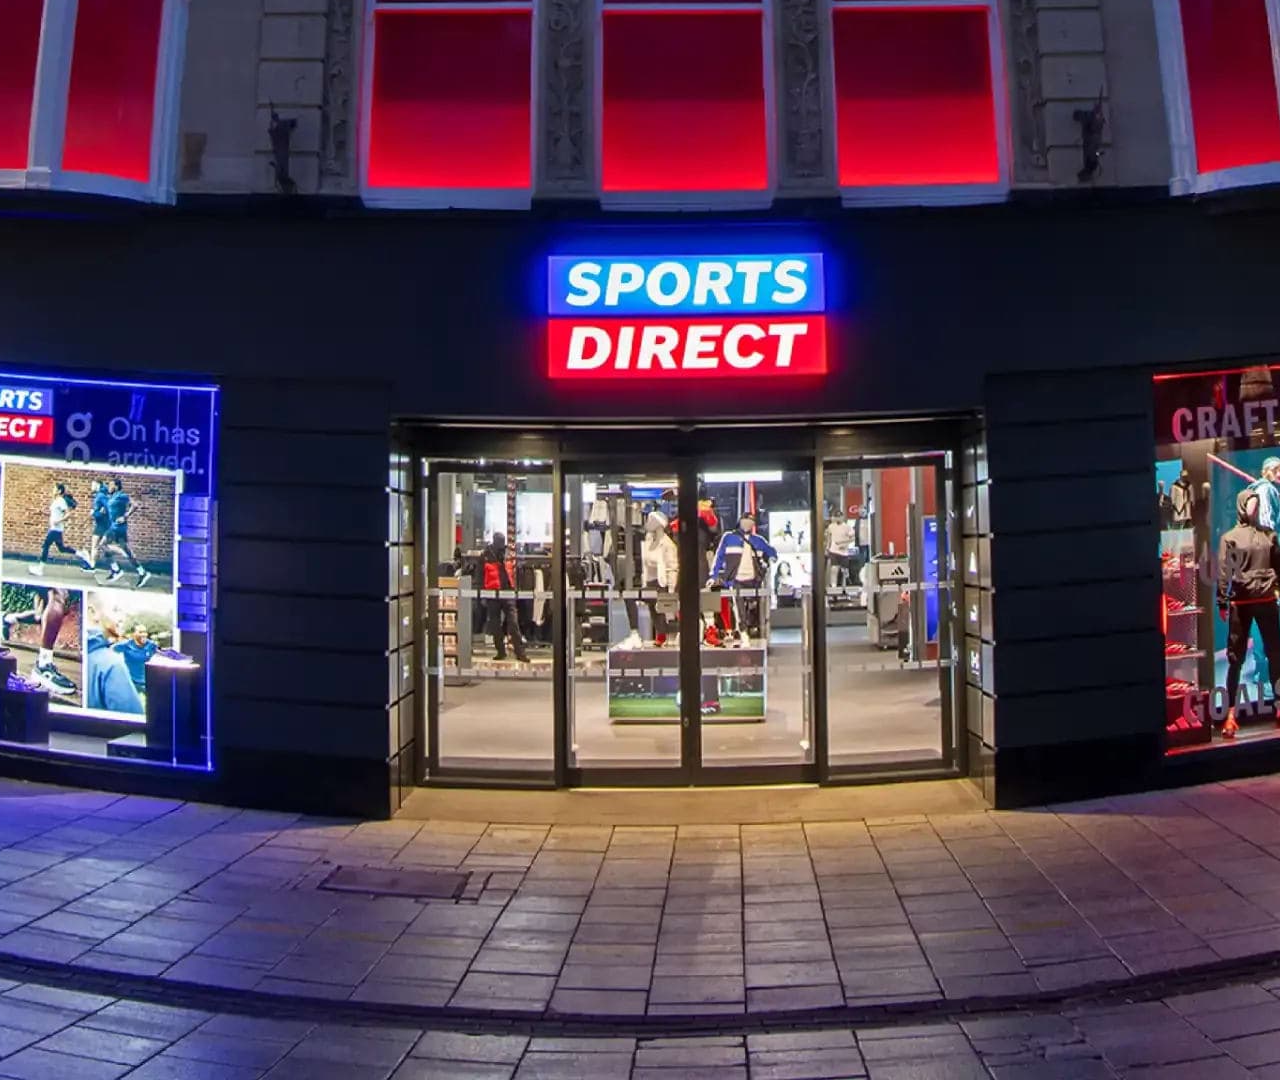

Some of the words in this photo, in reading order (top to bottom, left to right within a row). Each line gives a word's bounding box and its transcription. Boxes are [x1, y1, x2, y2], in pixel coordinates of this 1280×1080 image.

[565, 260, 808, 306] SPORTS
[566, 323, 808, 370] DIRECT
[108, 417, 147, 442] On
[155, 418, 201, 447] has
